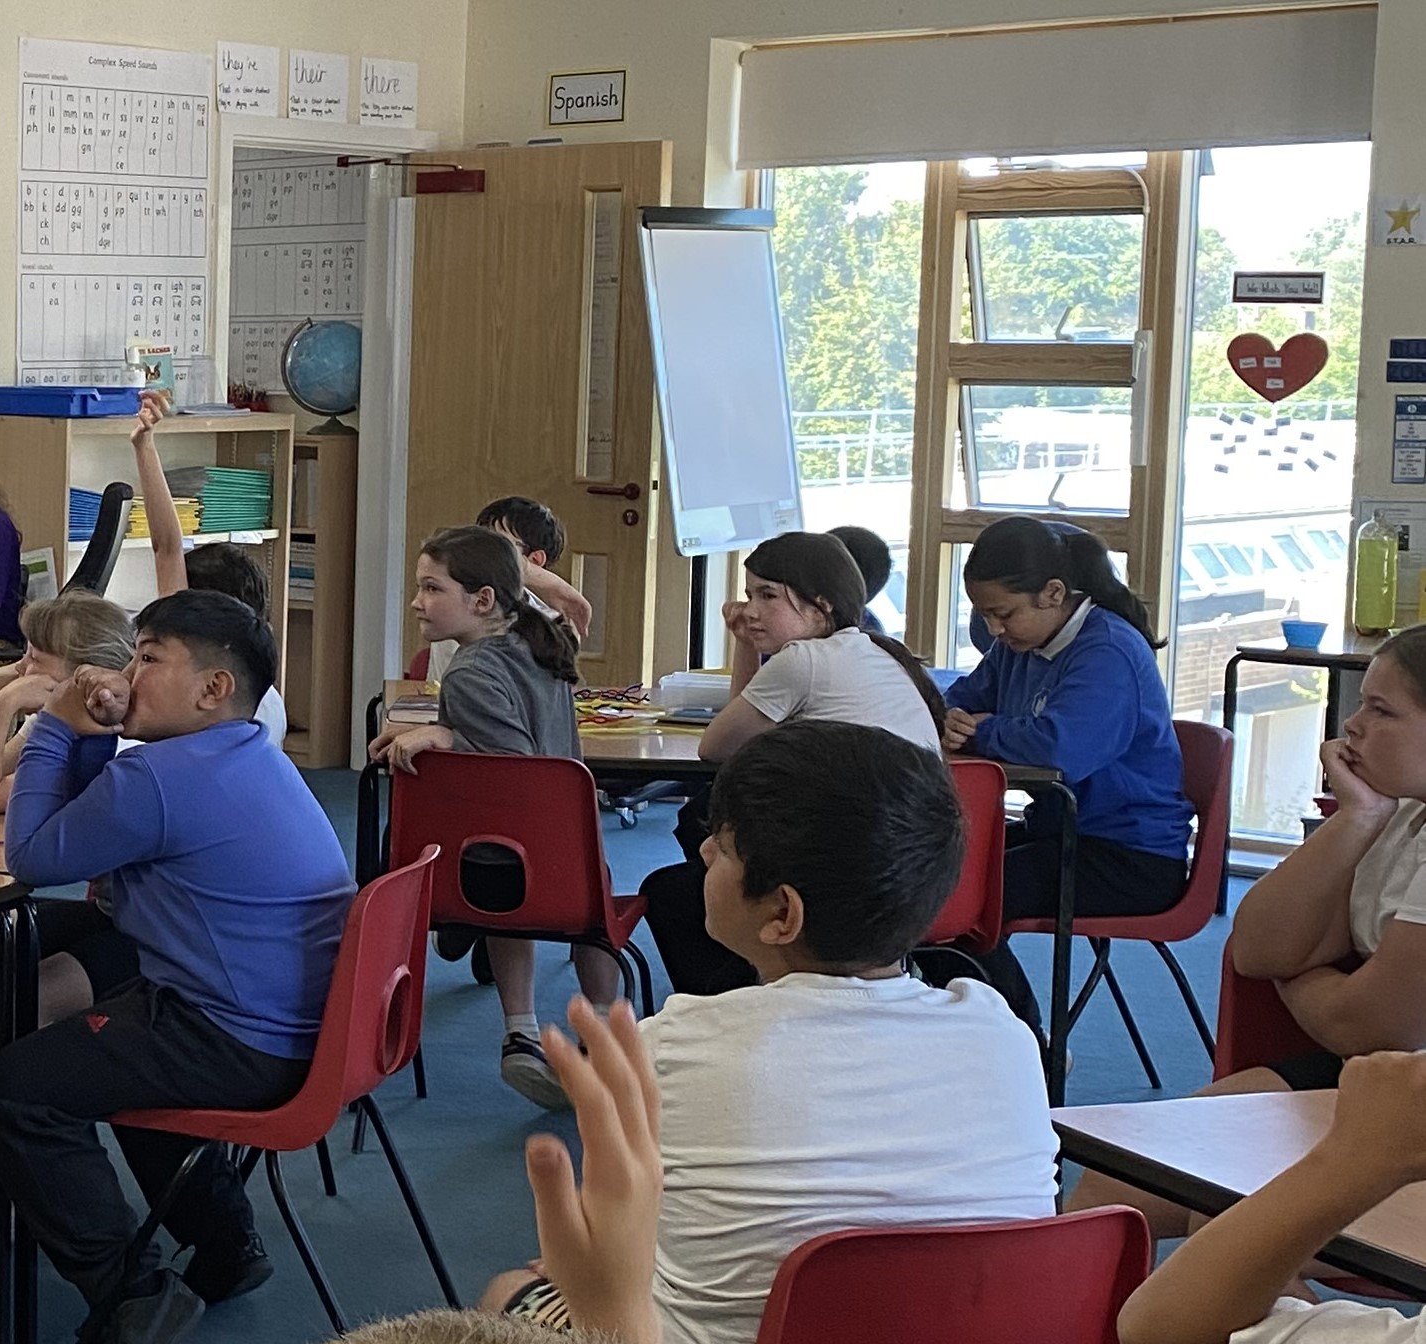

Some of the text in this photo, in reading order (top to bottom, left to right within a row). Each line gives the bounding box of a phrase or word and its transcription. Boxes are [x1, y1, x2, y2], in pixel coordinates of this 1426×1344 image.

[88, 56, 157, 70] Complex Speed Sounds
[295, 57, 327, 84] their
[364, 63, 400, 95] there
[554, 83, 618, 119] Spanish
[63, 110, 77, 119] mm
[83, 111, 93, 119] nn
[26, 123, 38, 135] ph
[48, 123, 55, 133] le
[63, 124, 76, 134] mb
[83, 126, 93, 135] kn
[81, 144, 91, 154] gn
[24, 202, 34, 212] bb
[55, 202, 66, 213] dd
[71, 206, 82, 216] gg
[40, 219, 48, 228] ck
[40, 235, 49, 245] ch
[1246, 282, 1319, 294] We Wish You Well
